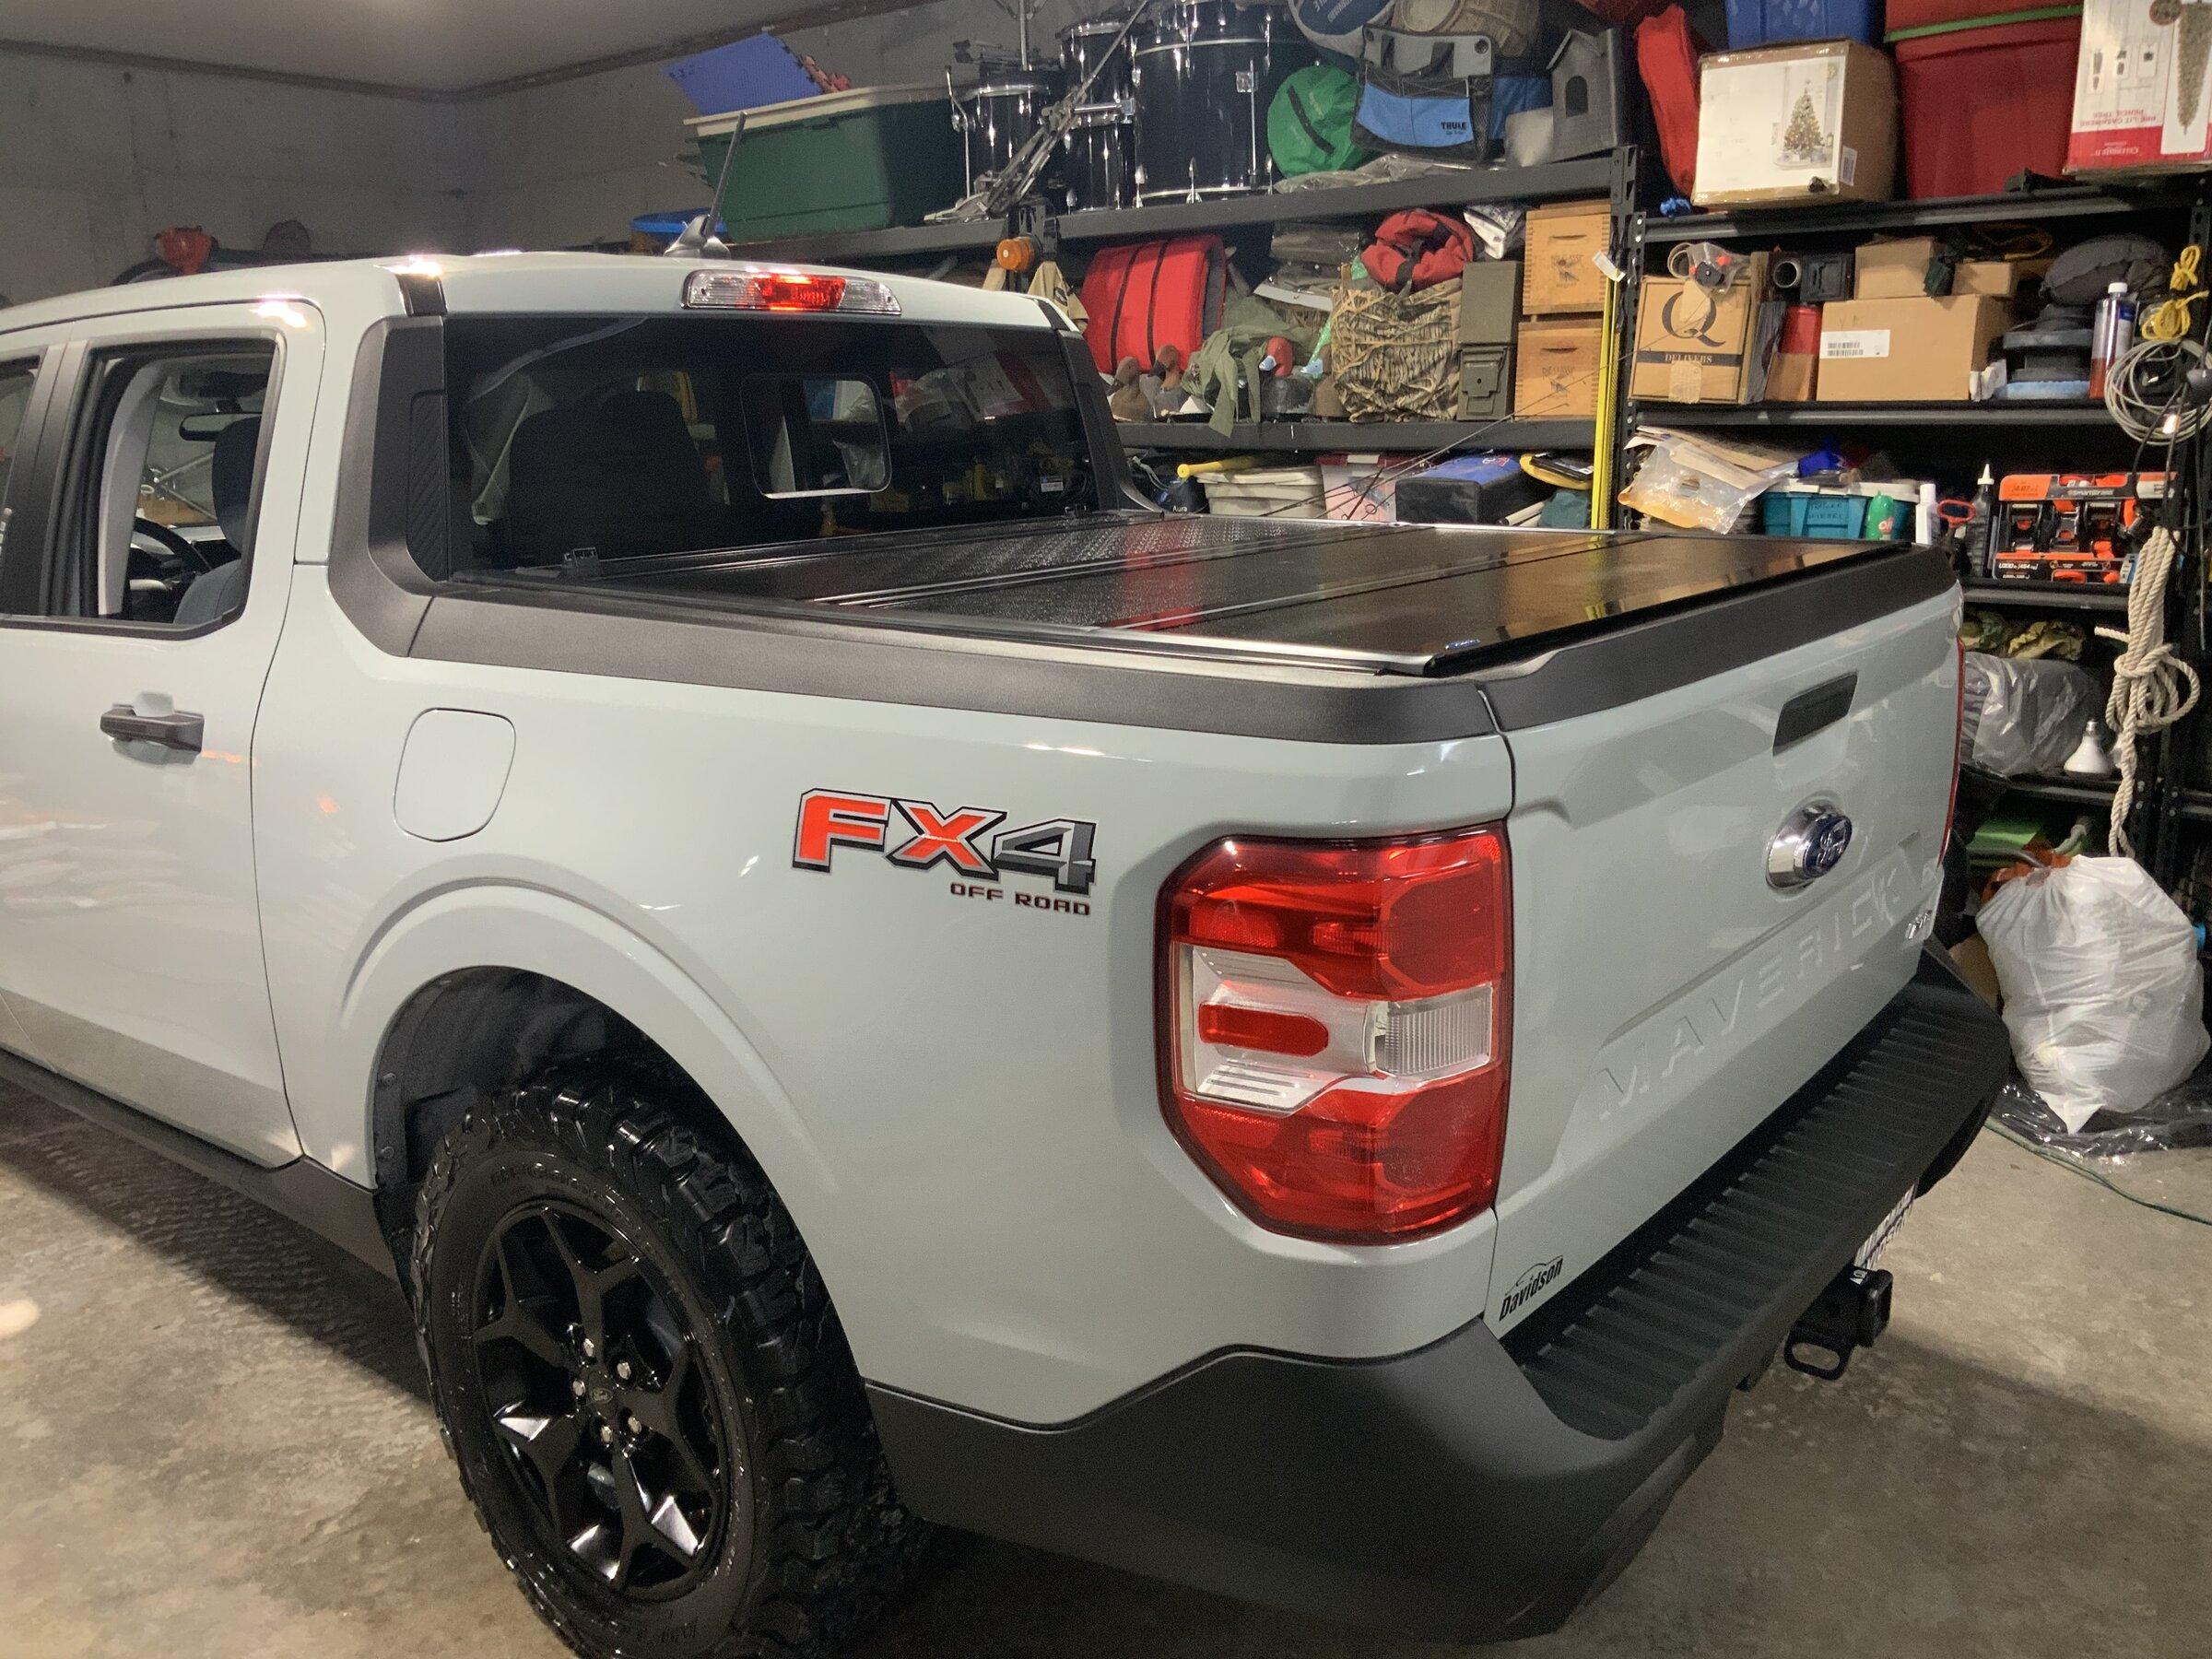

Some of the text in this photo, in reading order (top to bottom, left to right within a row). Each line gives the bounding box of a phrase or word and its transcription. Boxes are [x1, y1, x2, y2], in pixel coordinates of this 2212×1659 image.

[1441, 122, 1466, 131] THULE
[1661, 291, 1726, 347] Q
[1665, 353, 1712, 363] DELIVERS
[791, 787, 1099, 896] FX4
[949, 882, 1091, 916] OFF ROAD
[1599, 867, 1902, 1123] MAVERICK
[1499, 1257, 1564, 1322] Davidson
